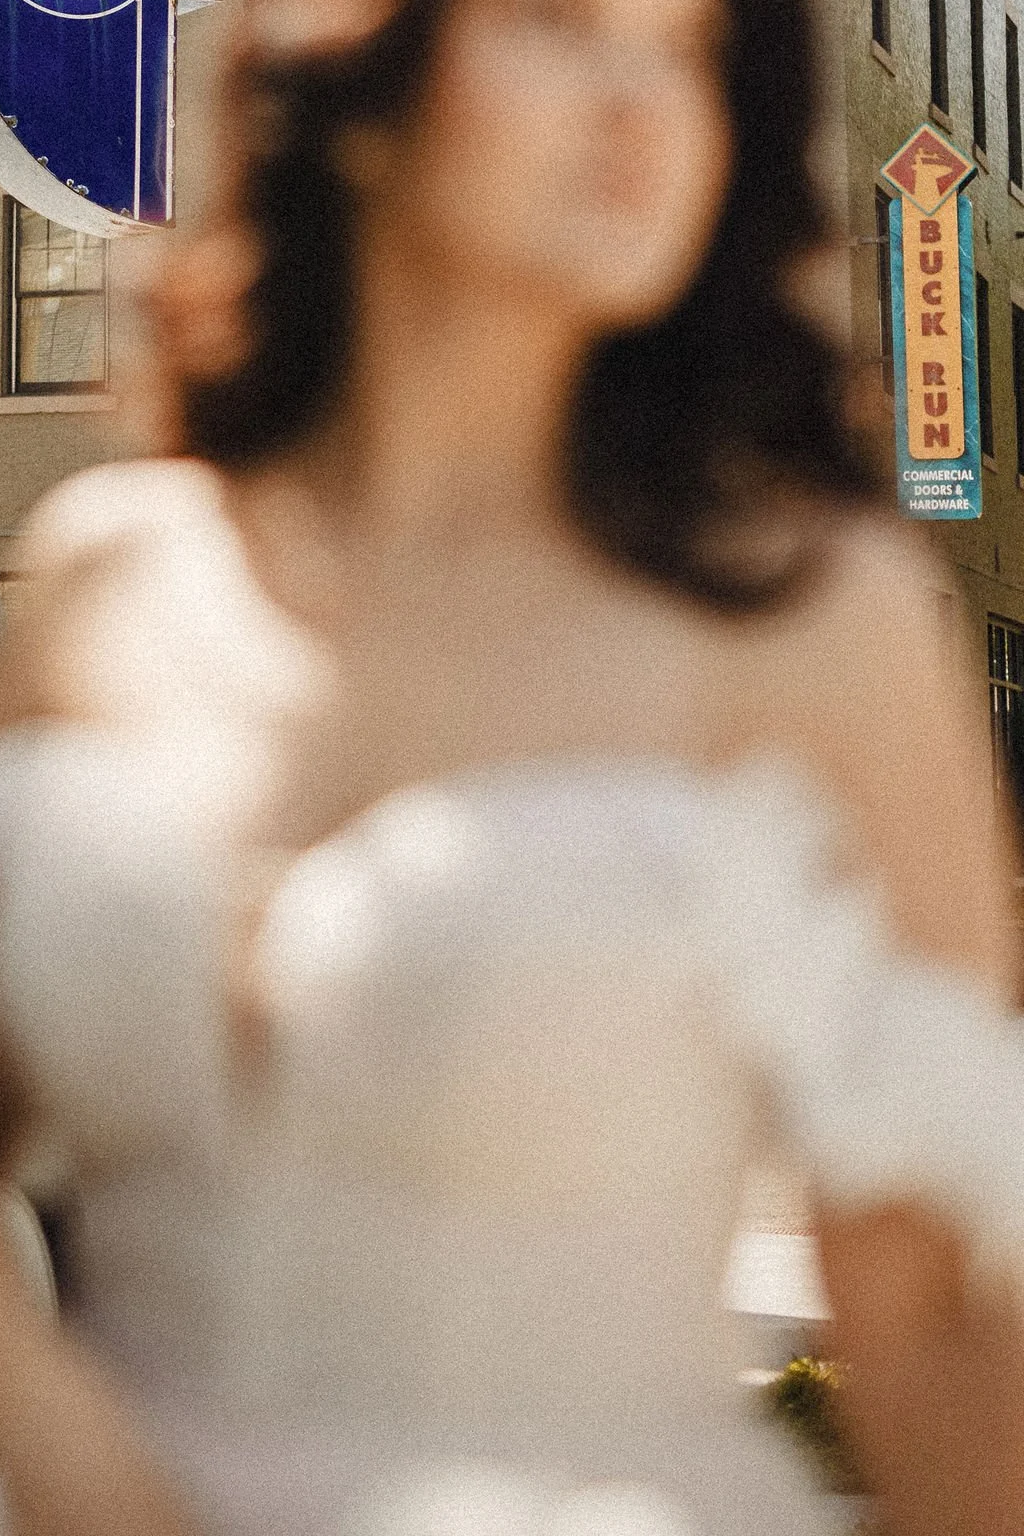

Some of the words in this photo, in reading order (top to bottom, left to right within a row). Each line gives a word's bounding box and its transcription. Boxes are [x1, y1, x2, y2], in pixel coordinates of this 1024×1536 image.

[919, 220, 948, 337] BUCK
[923, 362, 950, 448] RUN
[903, 470, 974, 481] COMMERCIAL
[914, 484, 953, 496] DOORS
[955, 484, 963, 495] &
[909, 498, 969, 510] HARDWARE
